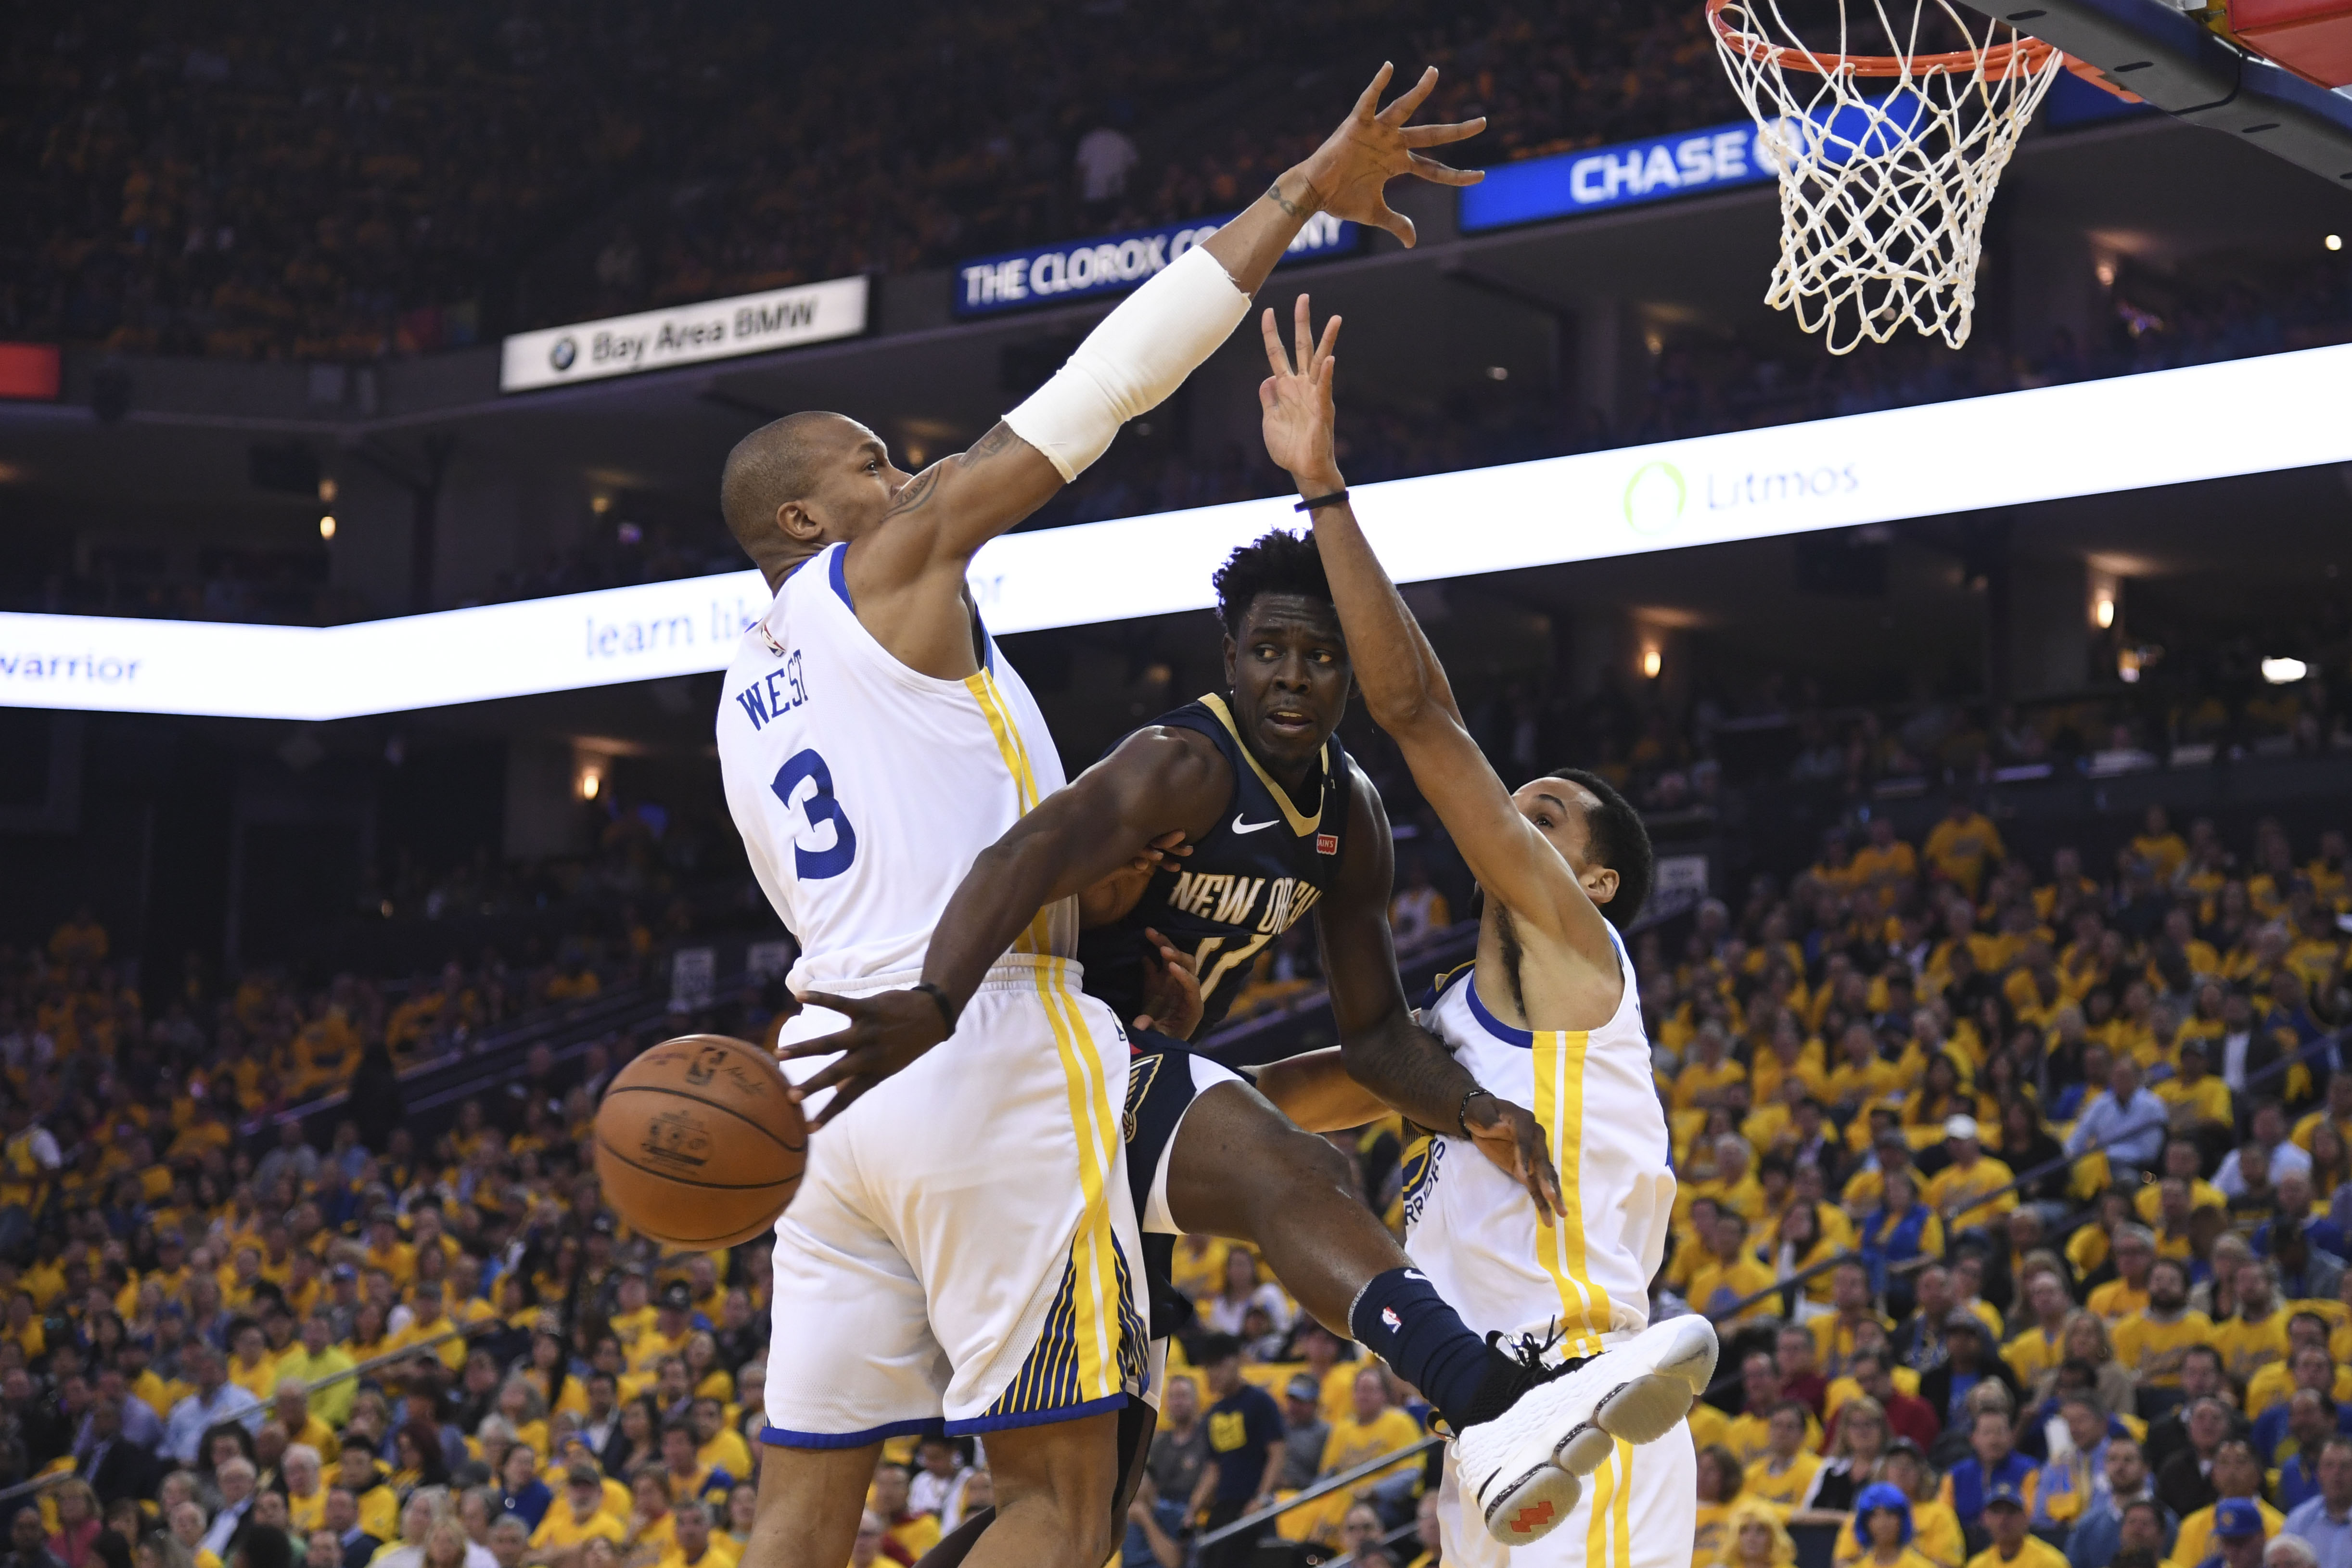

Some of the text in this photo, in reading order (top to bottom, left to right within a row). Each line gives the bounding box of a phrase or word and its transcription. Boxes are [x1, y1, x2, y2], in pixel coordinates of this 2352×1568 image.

[1570, 129, 1749, 204] CHASE
[963, 258, 1030, 306] THE
[1030, 235, 1167, 295] CLOROX
[591, 298, 819, 370] Bay Area BMW
[586, 597, 756, 658] learn lik
[736, 649, 808, 731] WEST
[770, 748, 856, 882] 3
[1167, 871, 1265, 925] NEW
